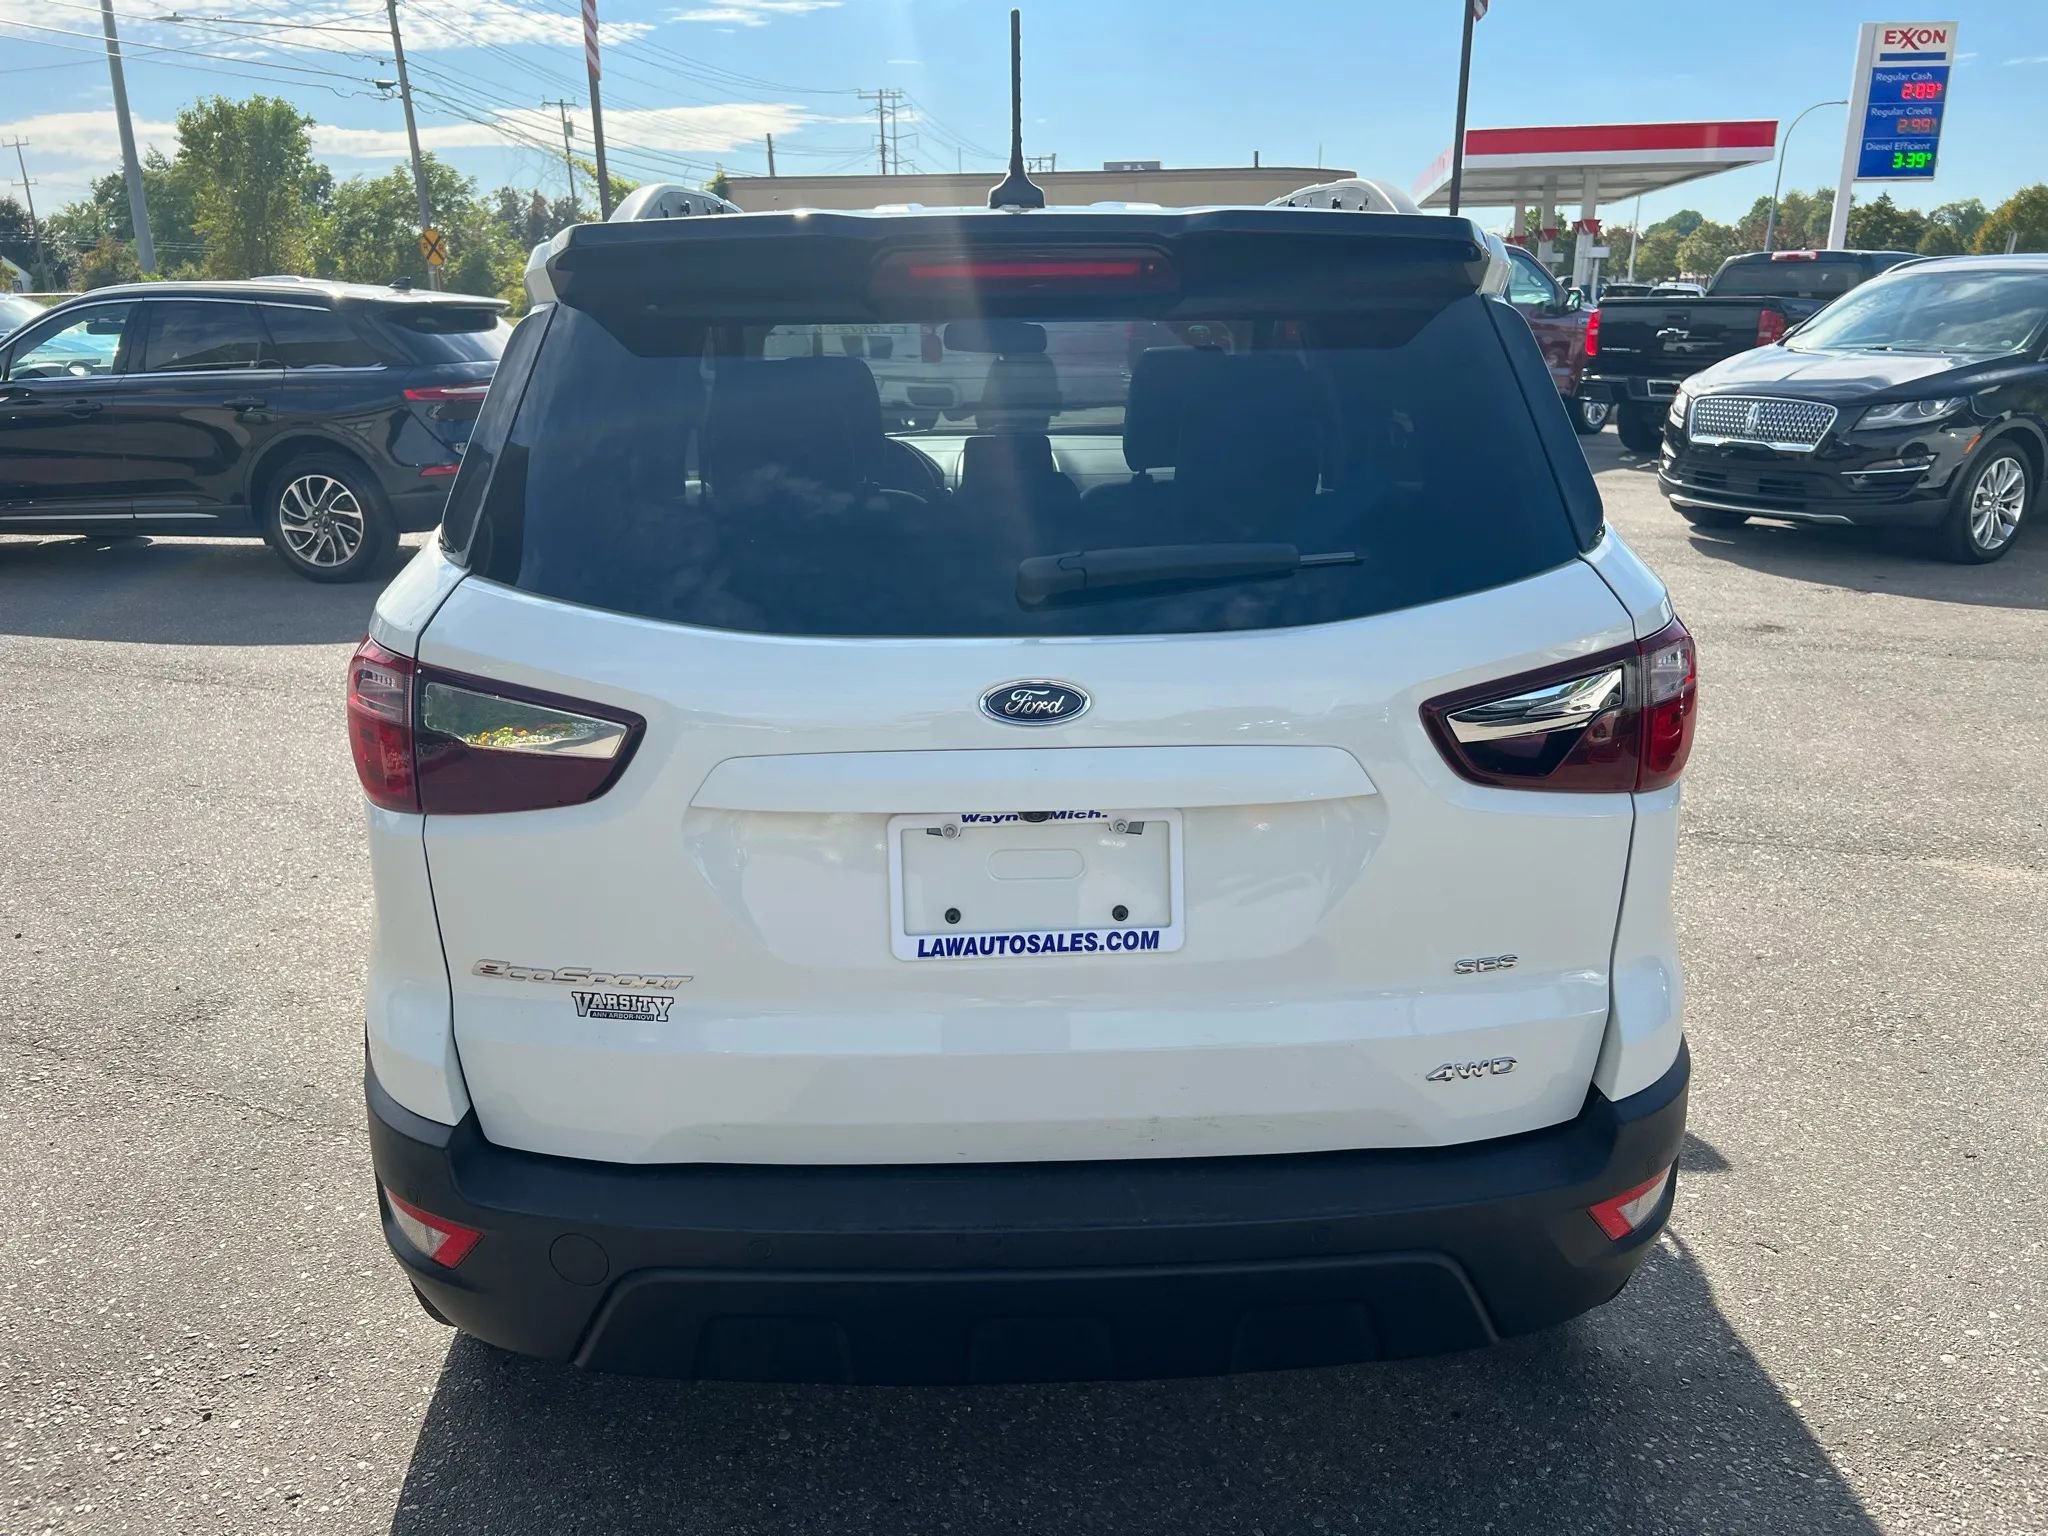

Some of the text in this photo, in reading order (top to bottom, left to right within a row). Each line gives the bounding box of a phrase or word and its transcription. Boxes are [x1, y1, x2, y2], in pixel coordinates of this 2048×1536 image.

[1884, 27, 1946, 50] EXXON
[1876, 72, 1933, 83] Regular Cash
[1871, 107, 1932, 118] Regular Credit
[1866, 142, 1931, 151] Diesel Efficient
[1004, 689, 1065, 714] Ford
[961, 810, 1108, 824] Wayn Mich.
[917, 930, 1160, 958] LAWAUTOSALES.COM
[1454, 954, 1519, 975] SES
[571, 991, 674, 1022] VARSITY
[1425, 1056, 1519, 1081] 4WD
